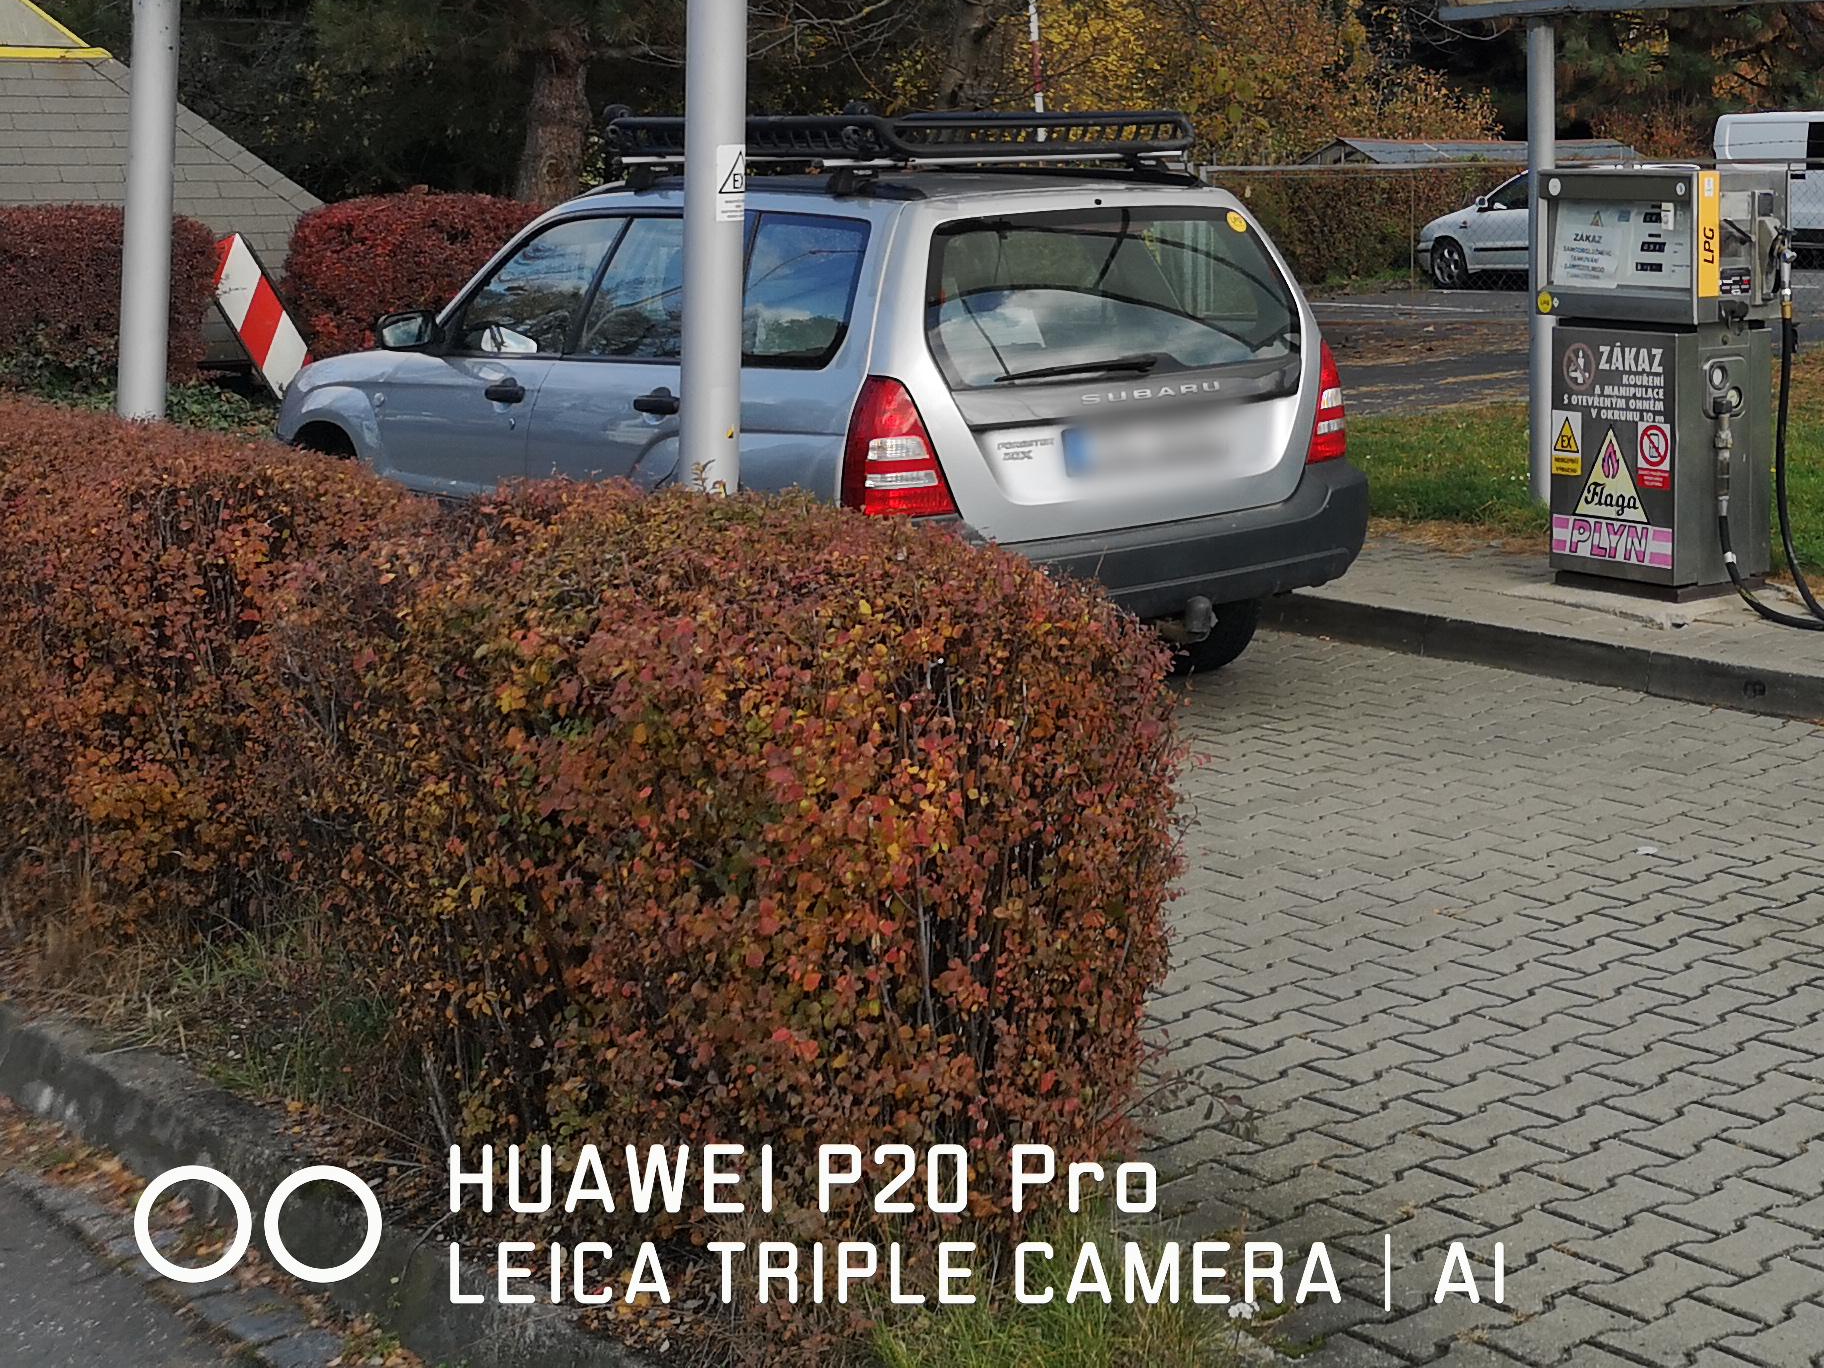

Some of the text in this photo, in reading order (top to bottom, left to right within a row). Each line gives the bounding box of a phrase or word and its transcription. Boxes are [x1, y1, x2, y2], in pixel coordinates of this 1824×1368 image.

[1703, 227, 1714, 264] LPG
[1599, 342, 1664, 373] ZÁKAZ
[1622, 373, 1664, 386] KOUŘENÍ
[1081, 381, 1220, 405] SUBARU
[1563, 393, 1664, 411] S OTEVŘENÝM OHNĚM
[1594, 384, 1664, 399] A MANIPULACE
[1590, 408, 1665, 423] V OKRUHU 10 m
[1561, 435, 1572, 448] EX
[1584, 482, 1639, 516] Flaga
[1569, 519, 1649, 564] PLYN
